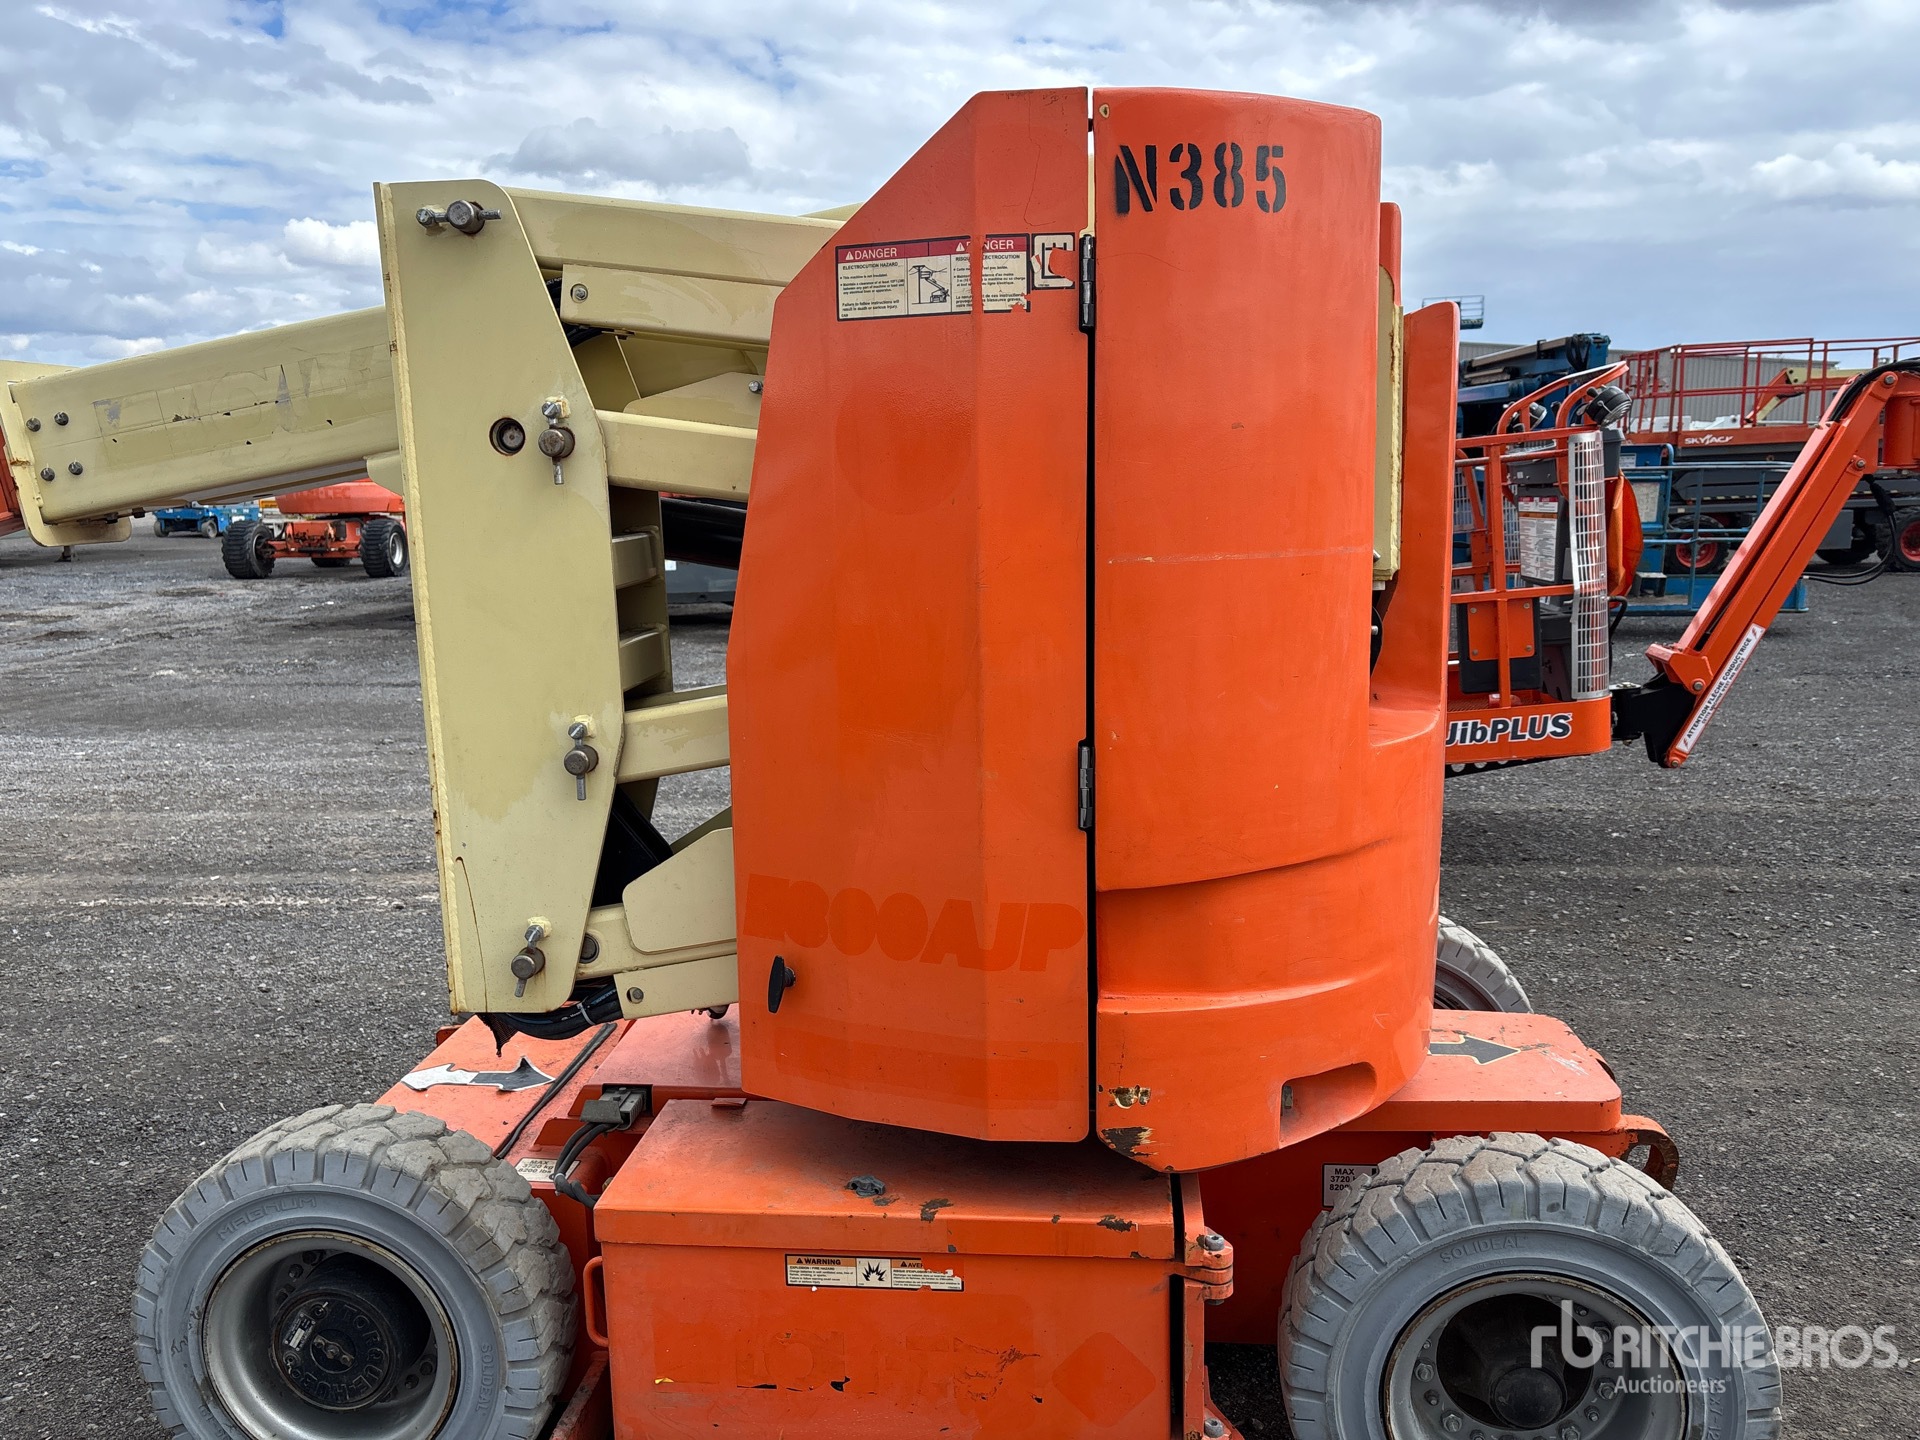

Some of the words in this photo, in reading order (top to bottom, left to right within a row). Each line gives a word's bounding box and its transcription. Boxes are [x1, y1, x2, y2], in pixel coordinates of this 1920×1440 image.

[1115, 142, 1286, 215] N385
[855, 248, 897, 260] DANGER
[1686, 704, 1710, 738] ATTENTION
[1707, 681, 1725, 704] FLECHE
[1722, 637, 1752, 681] CONDUCTRICE
[1446, 713, 1572, 746] JibPLUS
[1330, 1175, 1350, 1183] 3720
[217, 1195, 317, 1241] MAGNUM
[804, 1258, 841, 1266] WARNING
[1439, 1234, 1525, 1264] SOLIDEAL
[475, 1344, 494, 1412] SOLIDEAL
